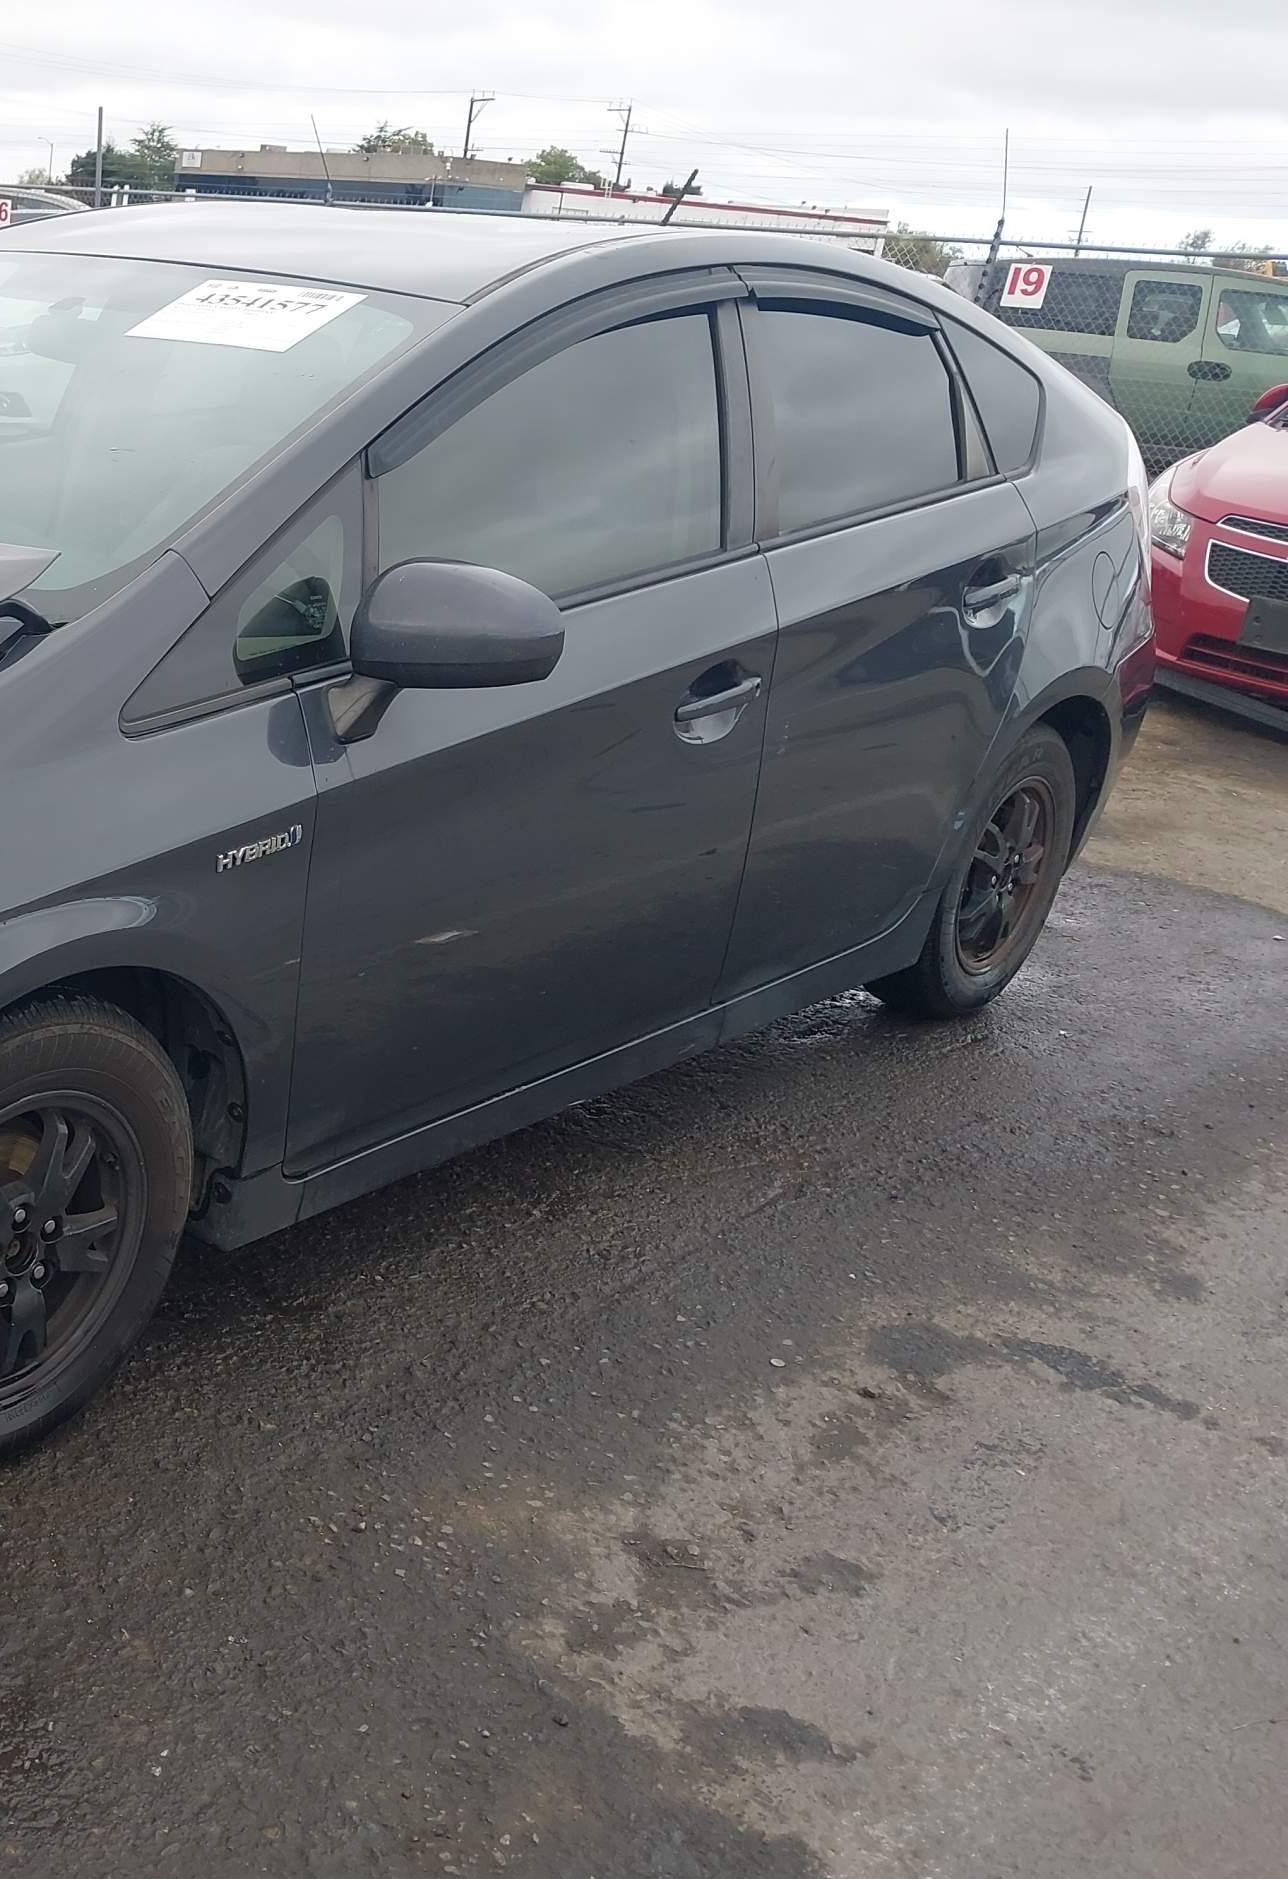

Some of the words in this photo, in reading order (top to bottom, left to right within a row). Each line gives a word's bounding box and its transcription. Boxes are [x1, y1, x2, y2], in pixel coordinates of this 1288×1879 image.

[1007, 267, 1045, 297] 19
[196, 293, 328, 315] 43541577
[215, 832, 290, 873] HYBRID
